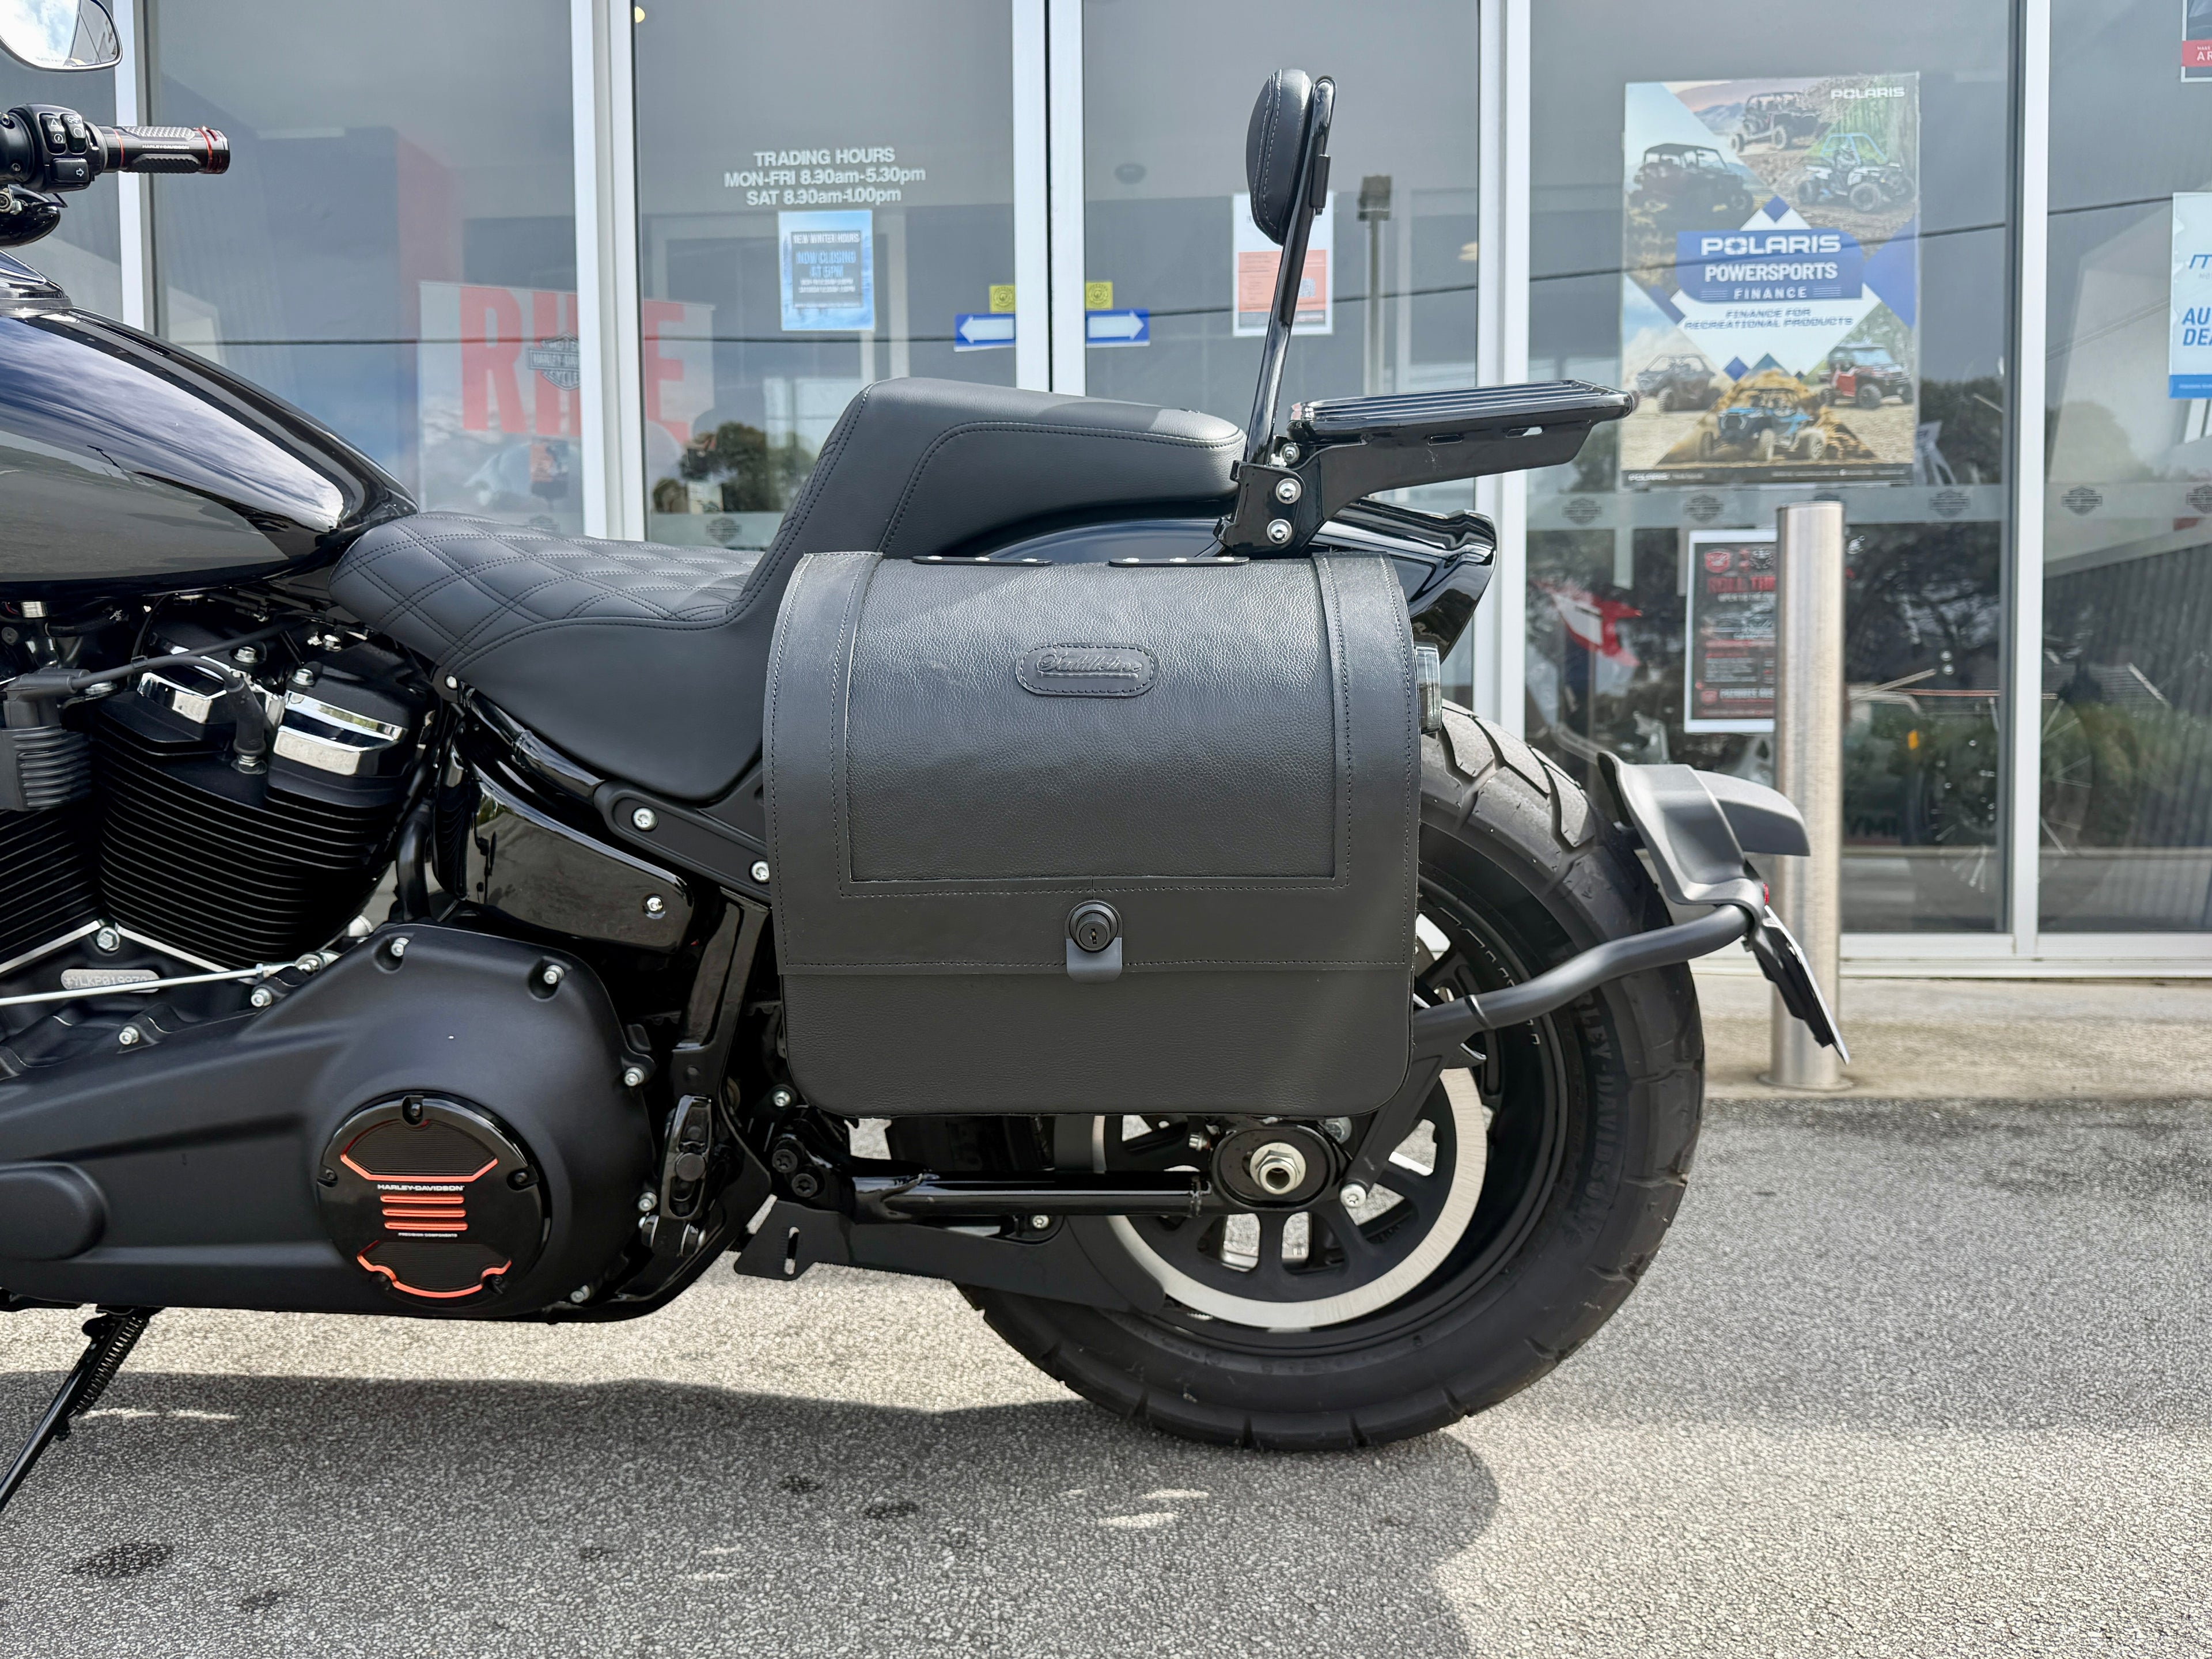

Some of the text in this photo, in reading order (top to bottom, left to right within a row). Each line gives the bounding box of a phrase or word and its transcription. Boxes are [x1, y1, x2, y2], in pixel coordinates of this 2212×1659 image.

[1831, 86, 1905, 99] POLARIS
[753, 146, 895, 167] TRADING HOURS
[724, 166, 926, 187] MON-FRI 8.30am-5.30pm
[746, 189, 779, 206] SAT
[1701, 234, 1842, 256] POLARIS
[1705, 262, 1838, 282] POWERSPORTS
[1733, 286, 1808, 300] FINANCE
[1726, 307, 1811, 319] FINANCE FOR
[1684, 316, 1854, 330] RECREATIONAL PRODUCTS
[2183, 328, 2212, 346] DE
[459, 286, 690, 445] RIE
[377, 1184, 464, 1192] HARLEY-DAVIDSON
